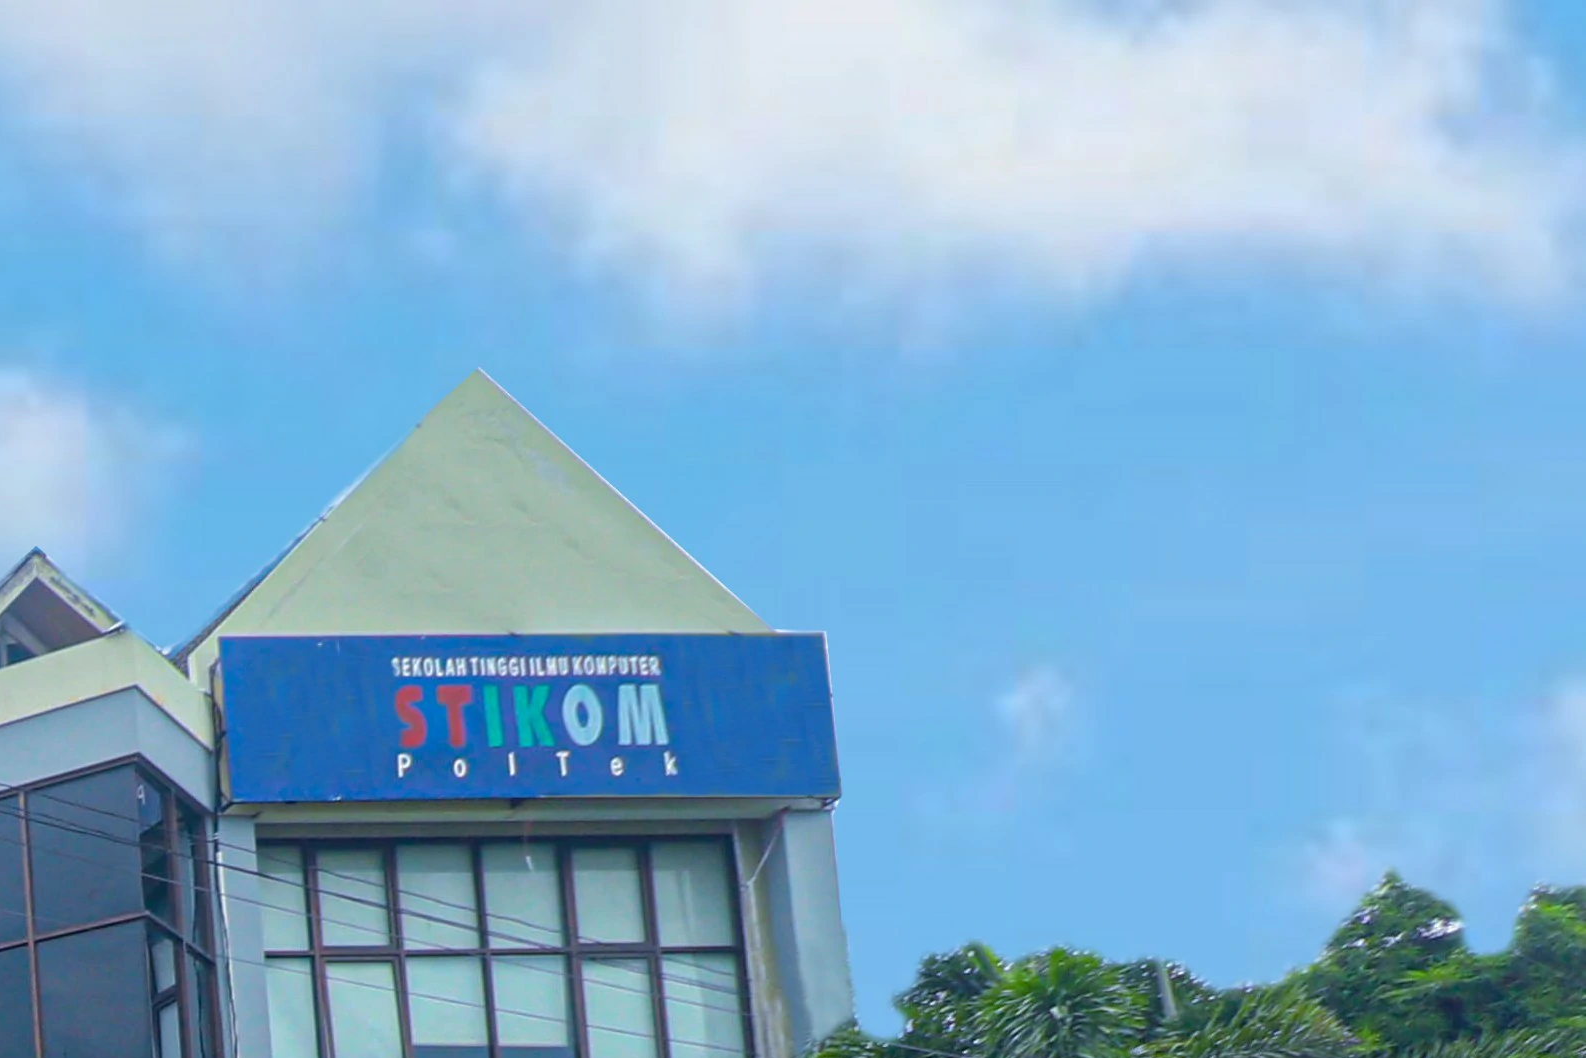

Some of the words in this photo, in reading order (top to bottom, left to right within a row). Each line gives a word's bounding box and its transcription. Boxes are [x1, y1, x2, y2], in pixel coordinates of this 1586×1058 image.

[391, 656, 467, 677] SEKOLAH
[469, 656, 526, 677] TINGGI
[528, 656, 569, 677] ILMU
[572, 656, 661, 677] KOMPUTER
[394, 684, 669, 747] STIKOM
